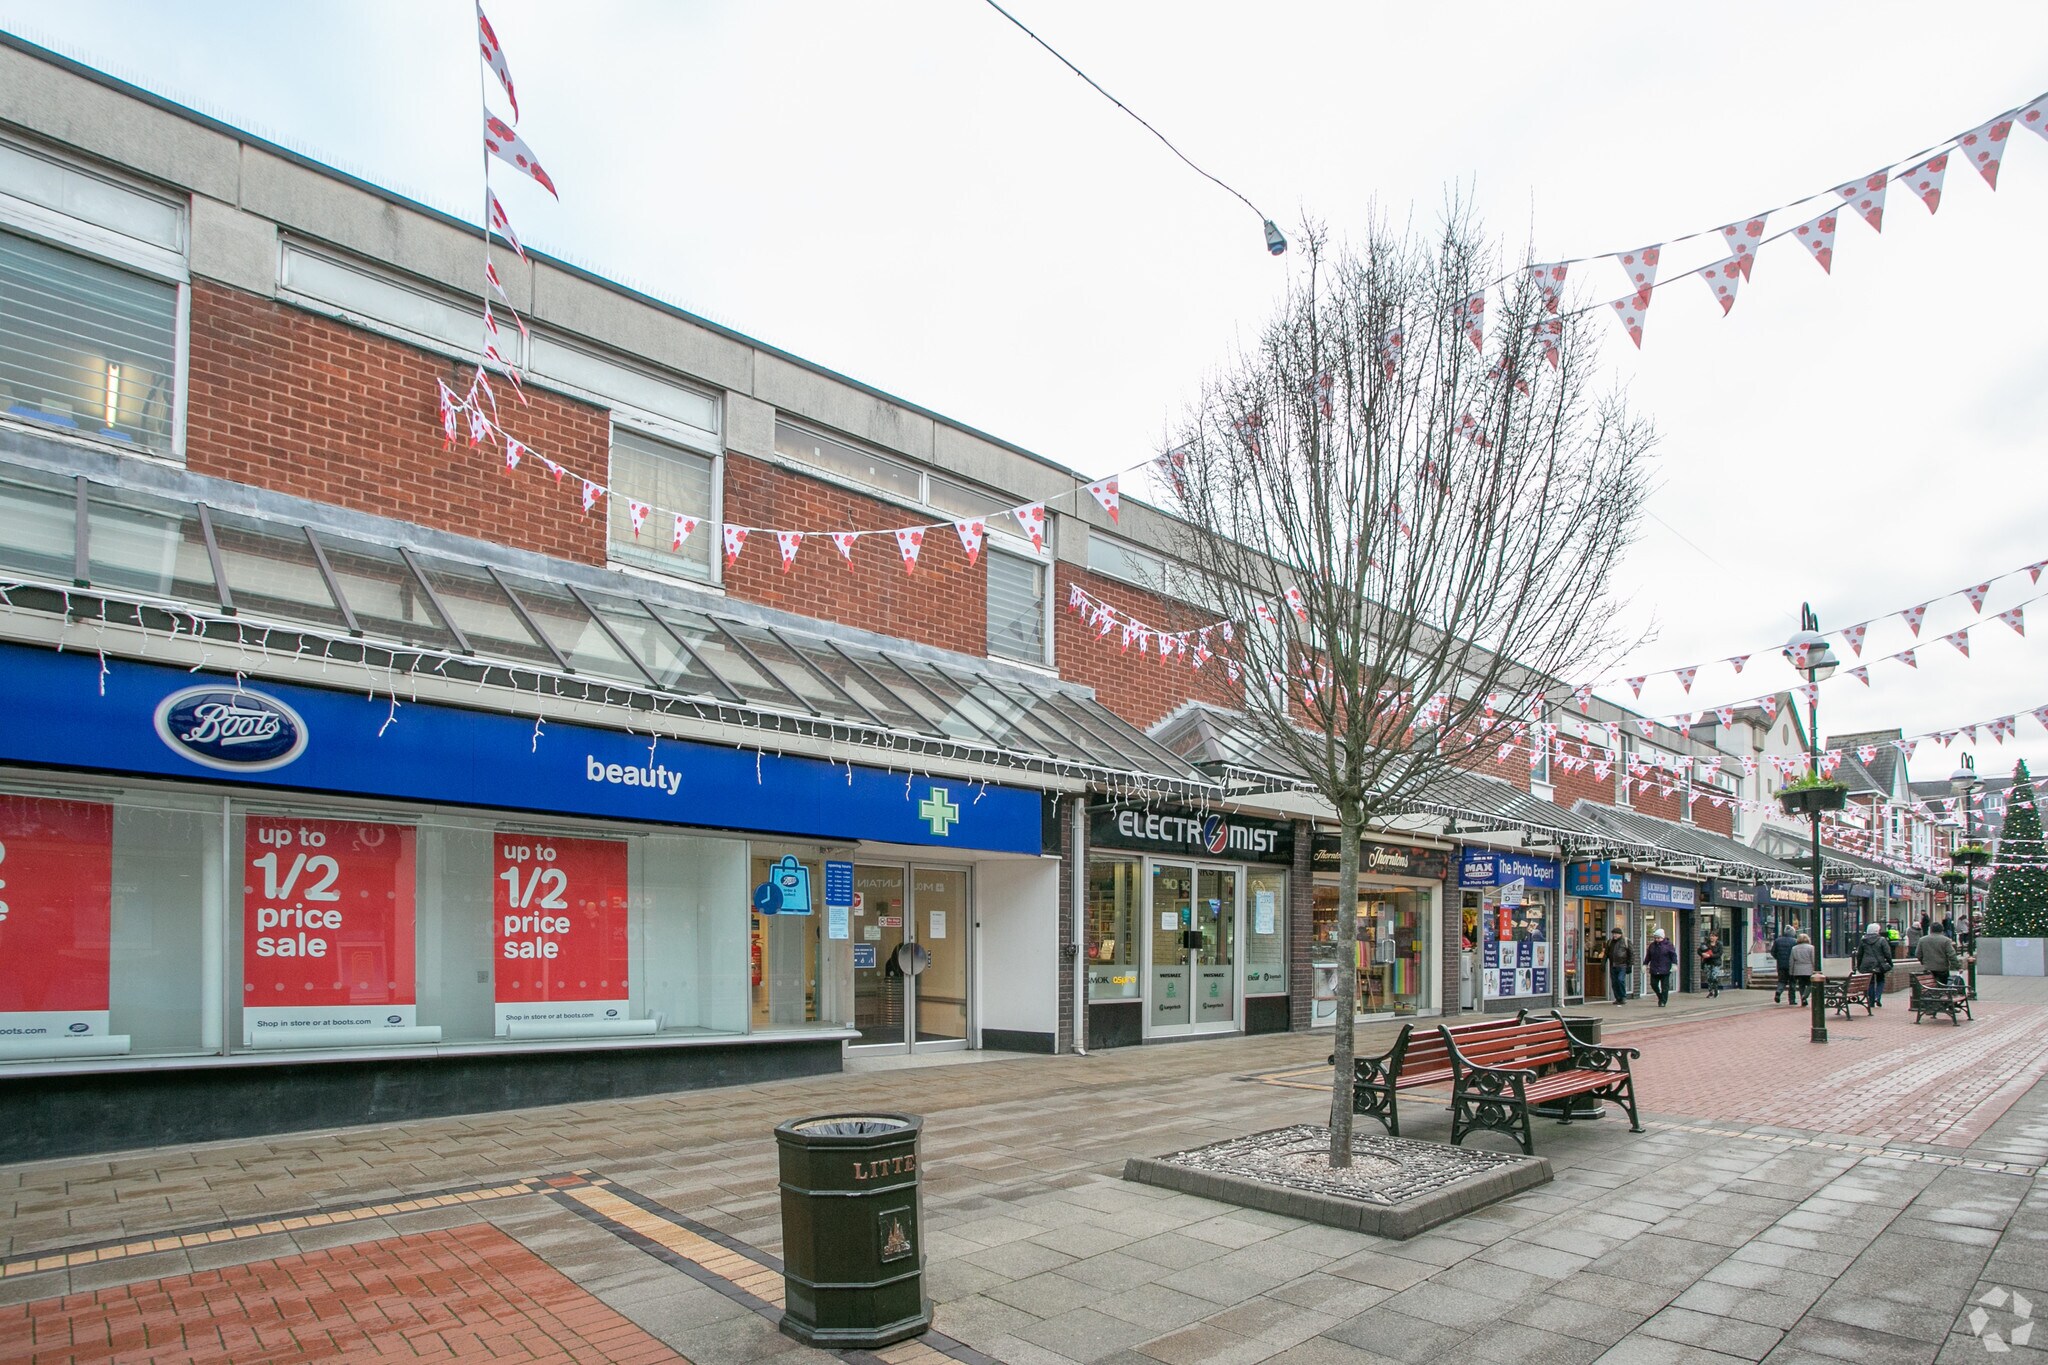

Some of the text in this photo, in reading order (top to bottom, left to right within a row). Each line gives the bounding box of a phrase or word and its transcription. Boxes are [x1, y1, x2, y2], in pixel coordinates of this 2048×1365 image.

[181, 703, 280, 746] Boots
[587, 754, 682, 795] beauty
[258, 826, 326, 849] up to
[503, 843, 557, 863] up to
[1313, 849, 1341, 861] Thornto
[1368, 846, 1409, 868] Thorntons
[252, 852, 340, 901] 1/2
[1465, 863, 1492, 872] MAX
[1500, 859, 1554, 881] The Photo Expert
[500, 866, 568, 909] 1/2
[1575, 884, 1604, 892] GREGGS
[1673, 889, 1693, 901] GIFT SHOP
[257, 903, 342, 932] price
[504, 911, 570, 937] price
[256, 932, 328, 957] sale
[503, 936, 559, 959] sale
[0, 1027, 47, 1036] oots.com
[257, 1020, 279, 1028] Shop
[332, 1018, 371, 1026] boots.com
[853, 1154, 916, 1180] LITTE
